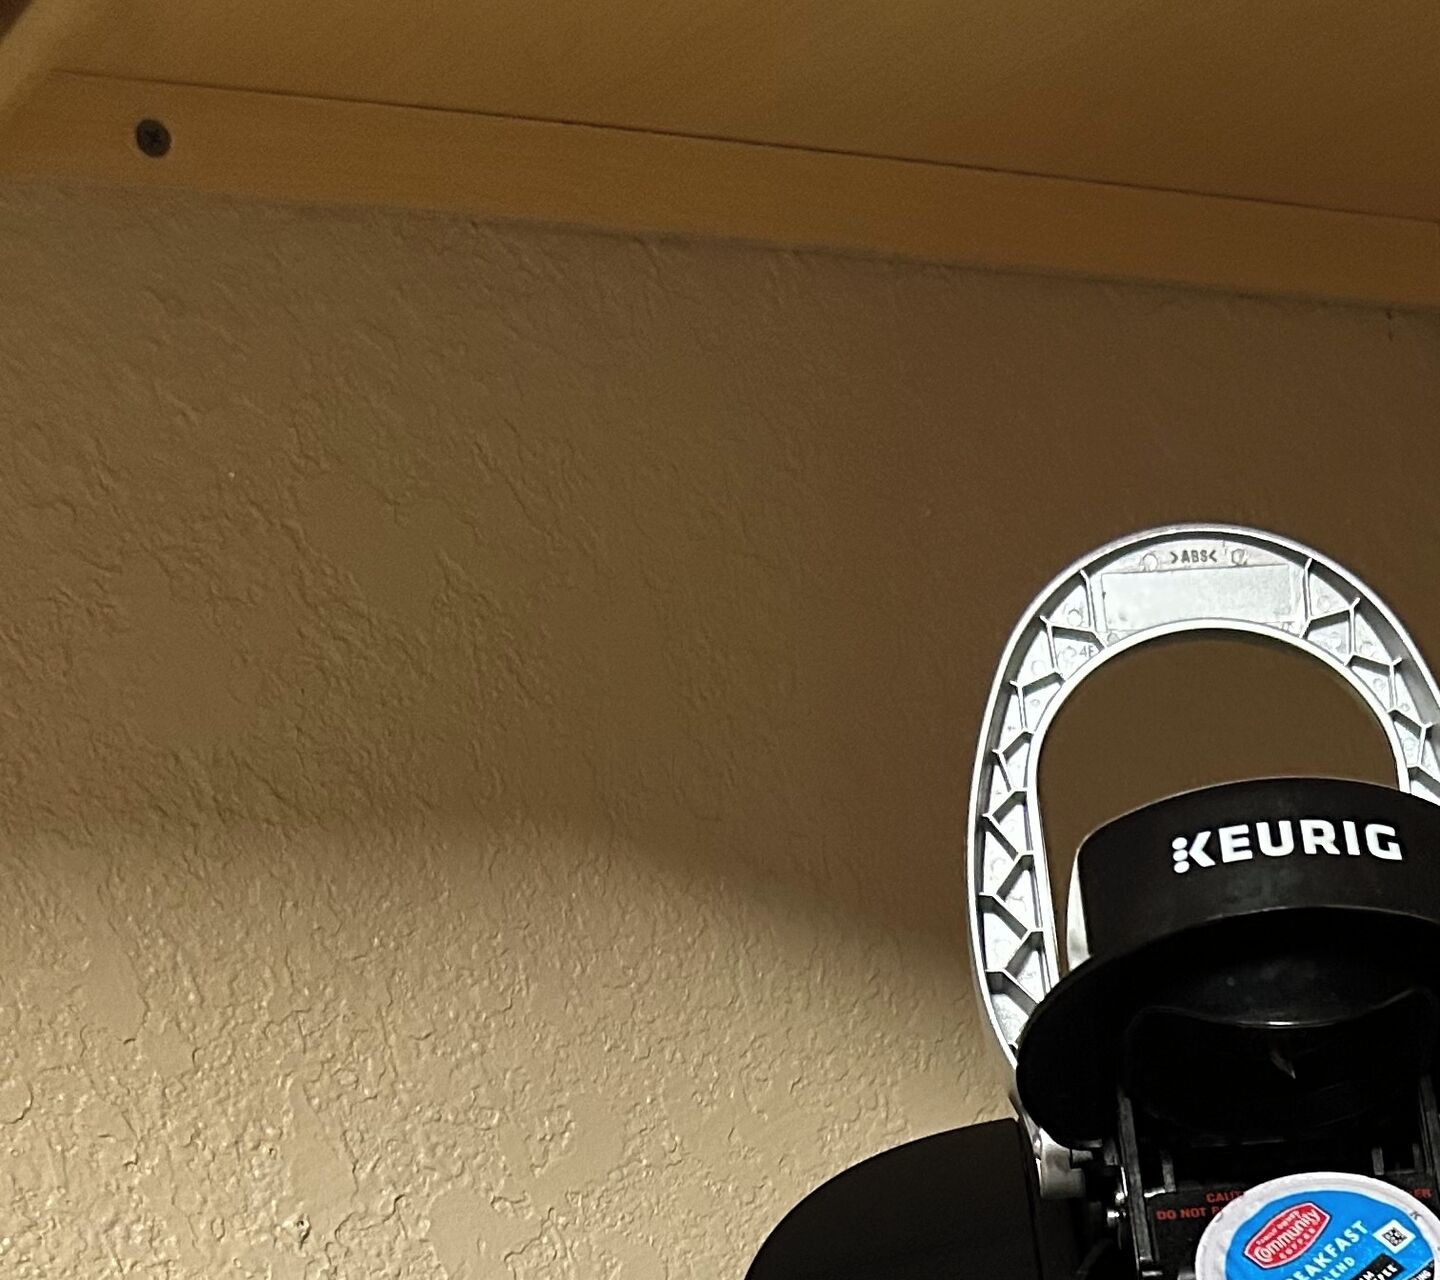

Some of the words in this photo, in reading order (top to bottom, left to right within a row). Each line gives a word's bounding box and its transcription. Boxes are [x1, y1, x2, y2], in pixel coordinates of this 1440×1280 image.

[1172, 819, 1403, 873] KEURIG
[1156, 1210, 1176, 1220] DO
[1180, 1207, 1207, 1218] NOT
[1254, 1208, 1321, 1262] Community
